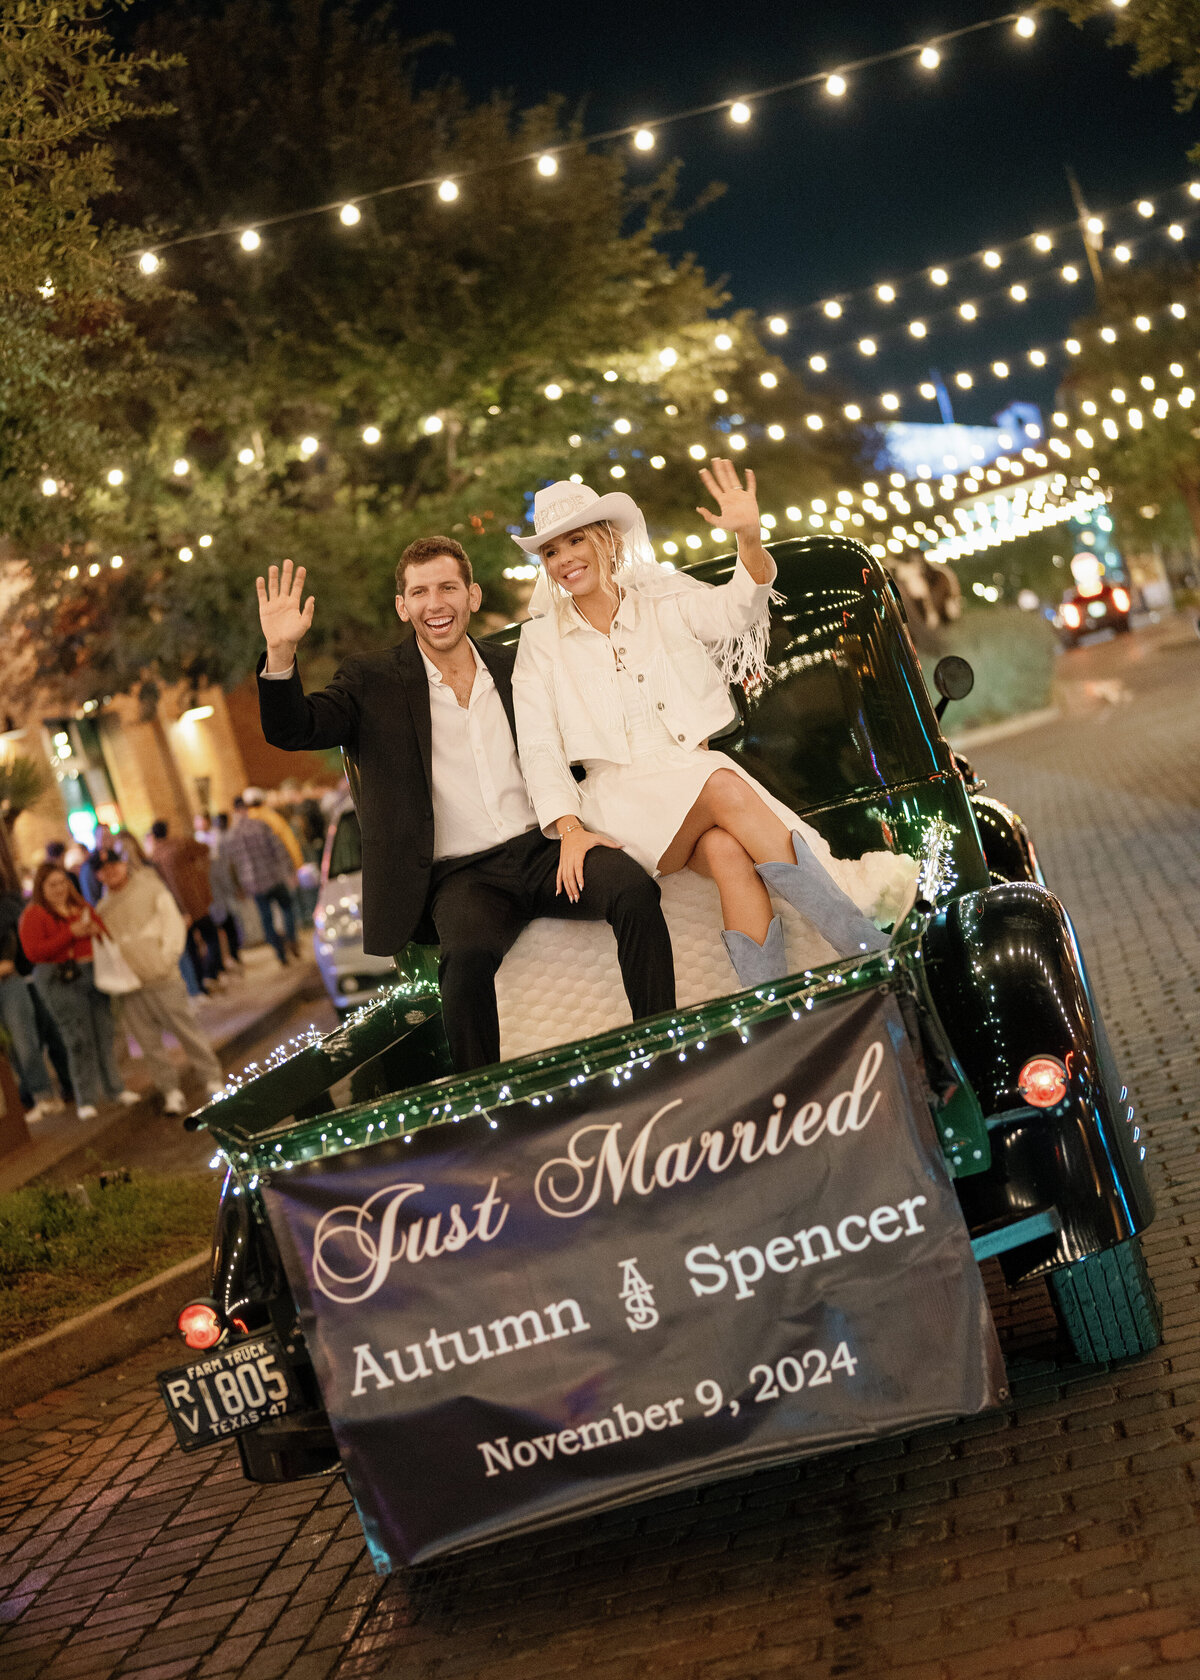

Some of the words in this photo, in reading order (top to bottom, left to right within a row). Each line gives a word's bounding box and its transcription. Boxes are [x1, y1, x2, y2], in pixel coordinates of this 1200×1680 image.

[312, 1177, 510, 1304] Just
[534, 1041, 884, 1219] Married
[186, 1358, 223, 1380] FARM
[224, 1343, 268, 1367] TRUCK
[350, 1298, 590, 1397] Autumn
[684, 1195, 928, 1301] Spencer
[477, 1398, 684, 1477] November
[695, 1378, 741, 1418] 9,
[748, 1341, 858, 1403] 2024
